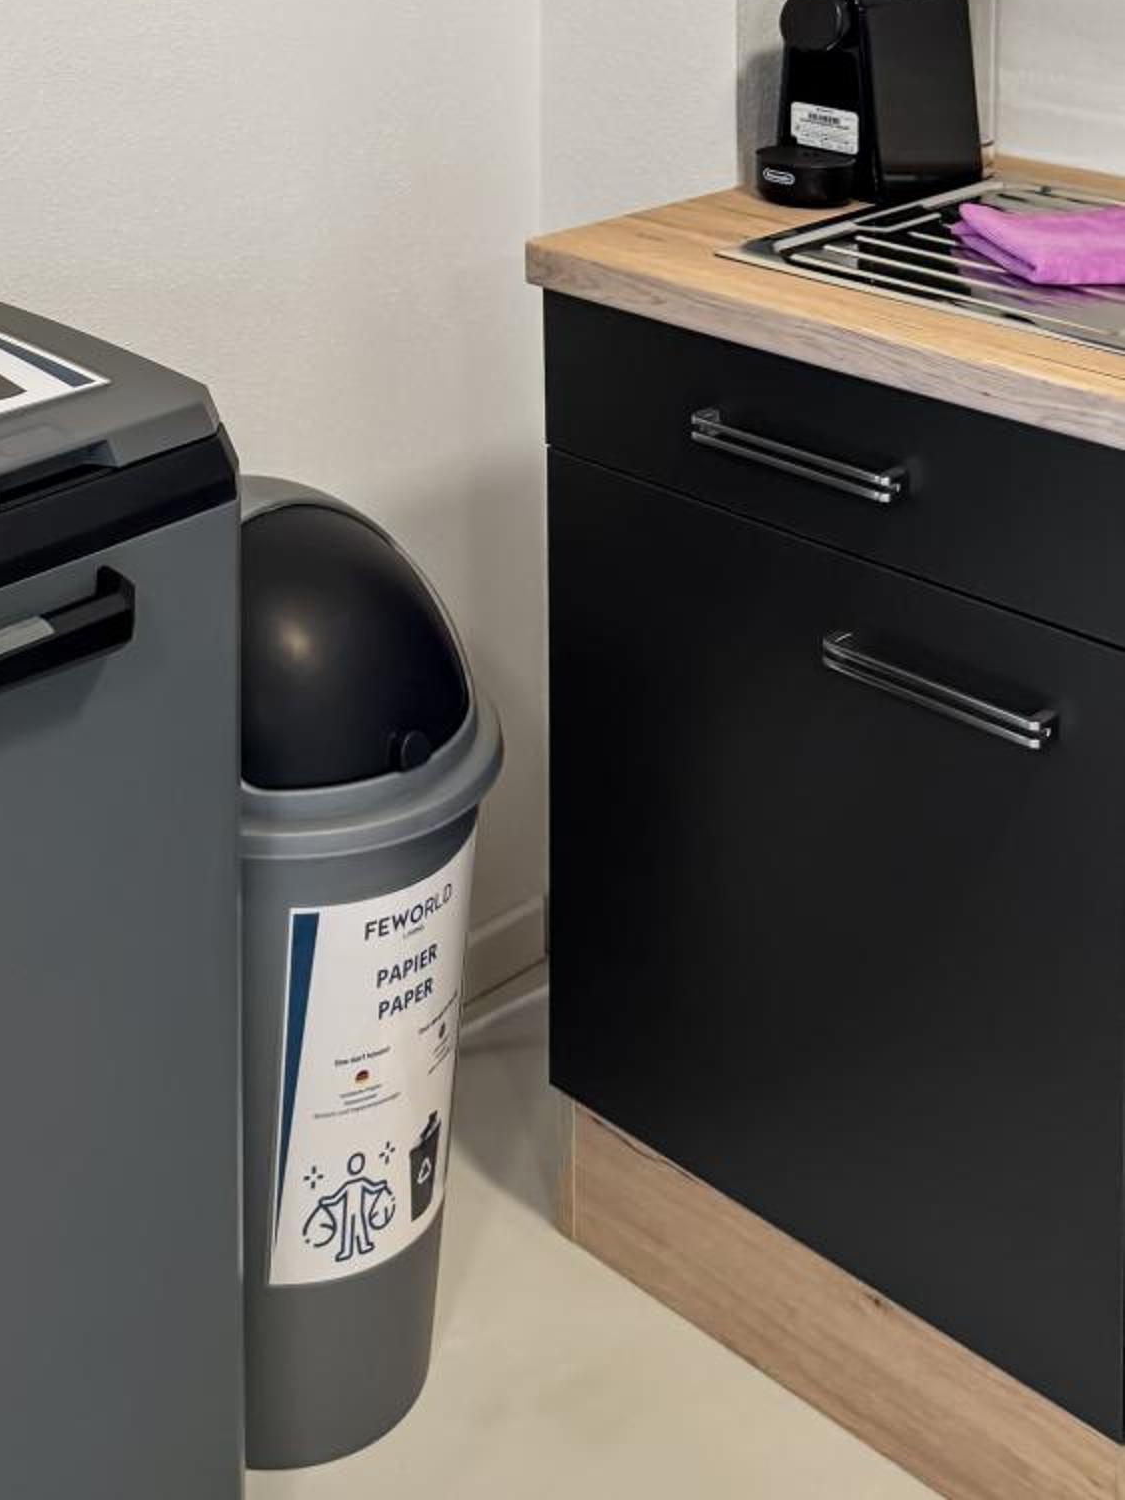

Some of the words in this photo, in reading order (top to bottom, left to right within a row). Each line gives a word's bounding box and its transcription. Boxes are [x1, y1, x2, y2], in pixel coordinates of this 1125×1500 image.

[364, 882, 453, 942] FEWORLD
[376, 942, 438, 990] PAPIER
[378, 976, 434, 1021] PAPER
